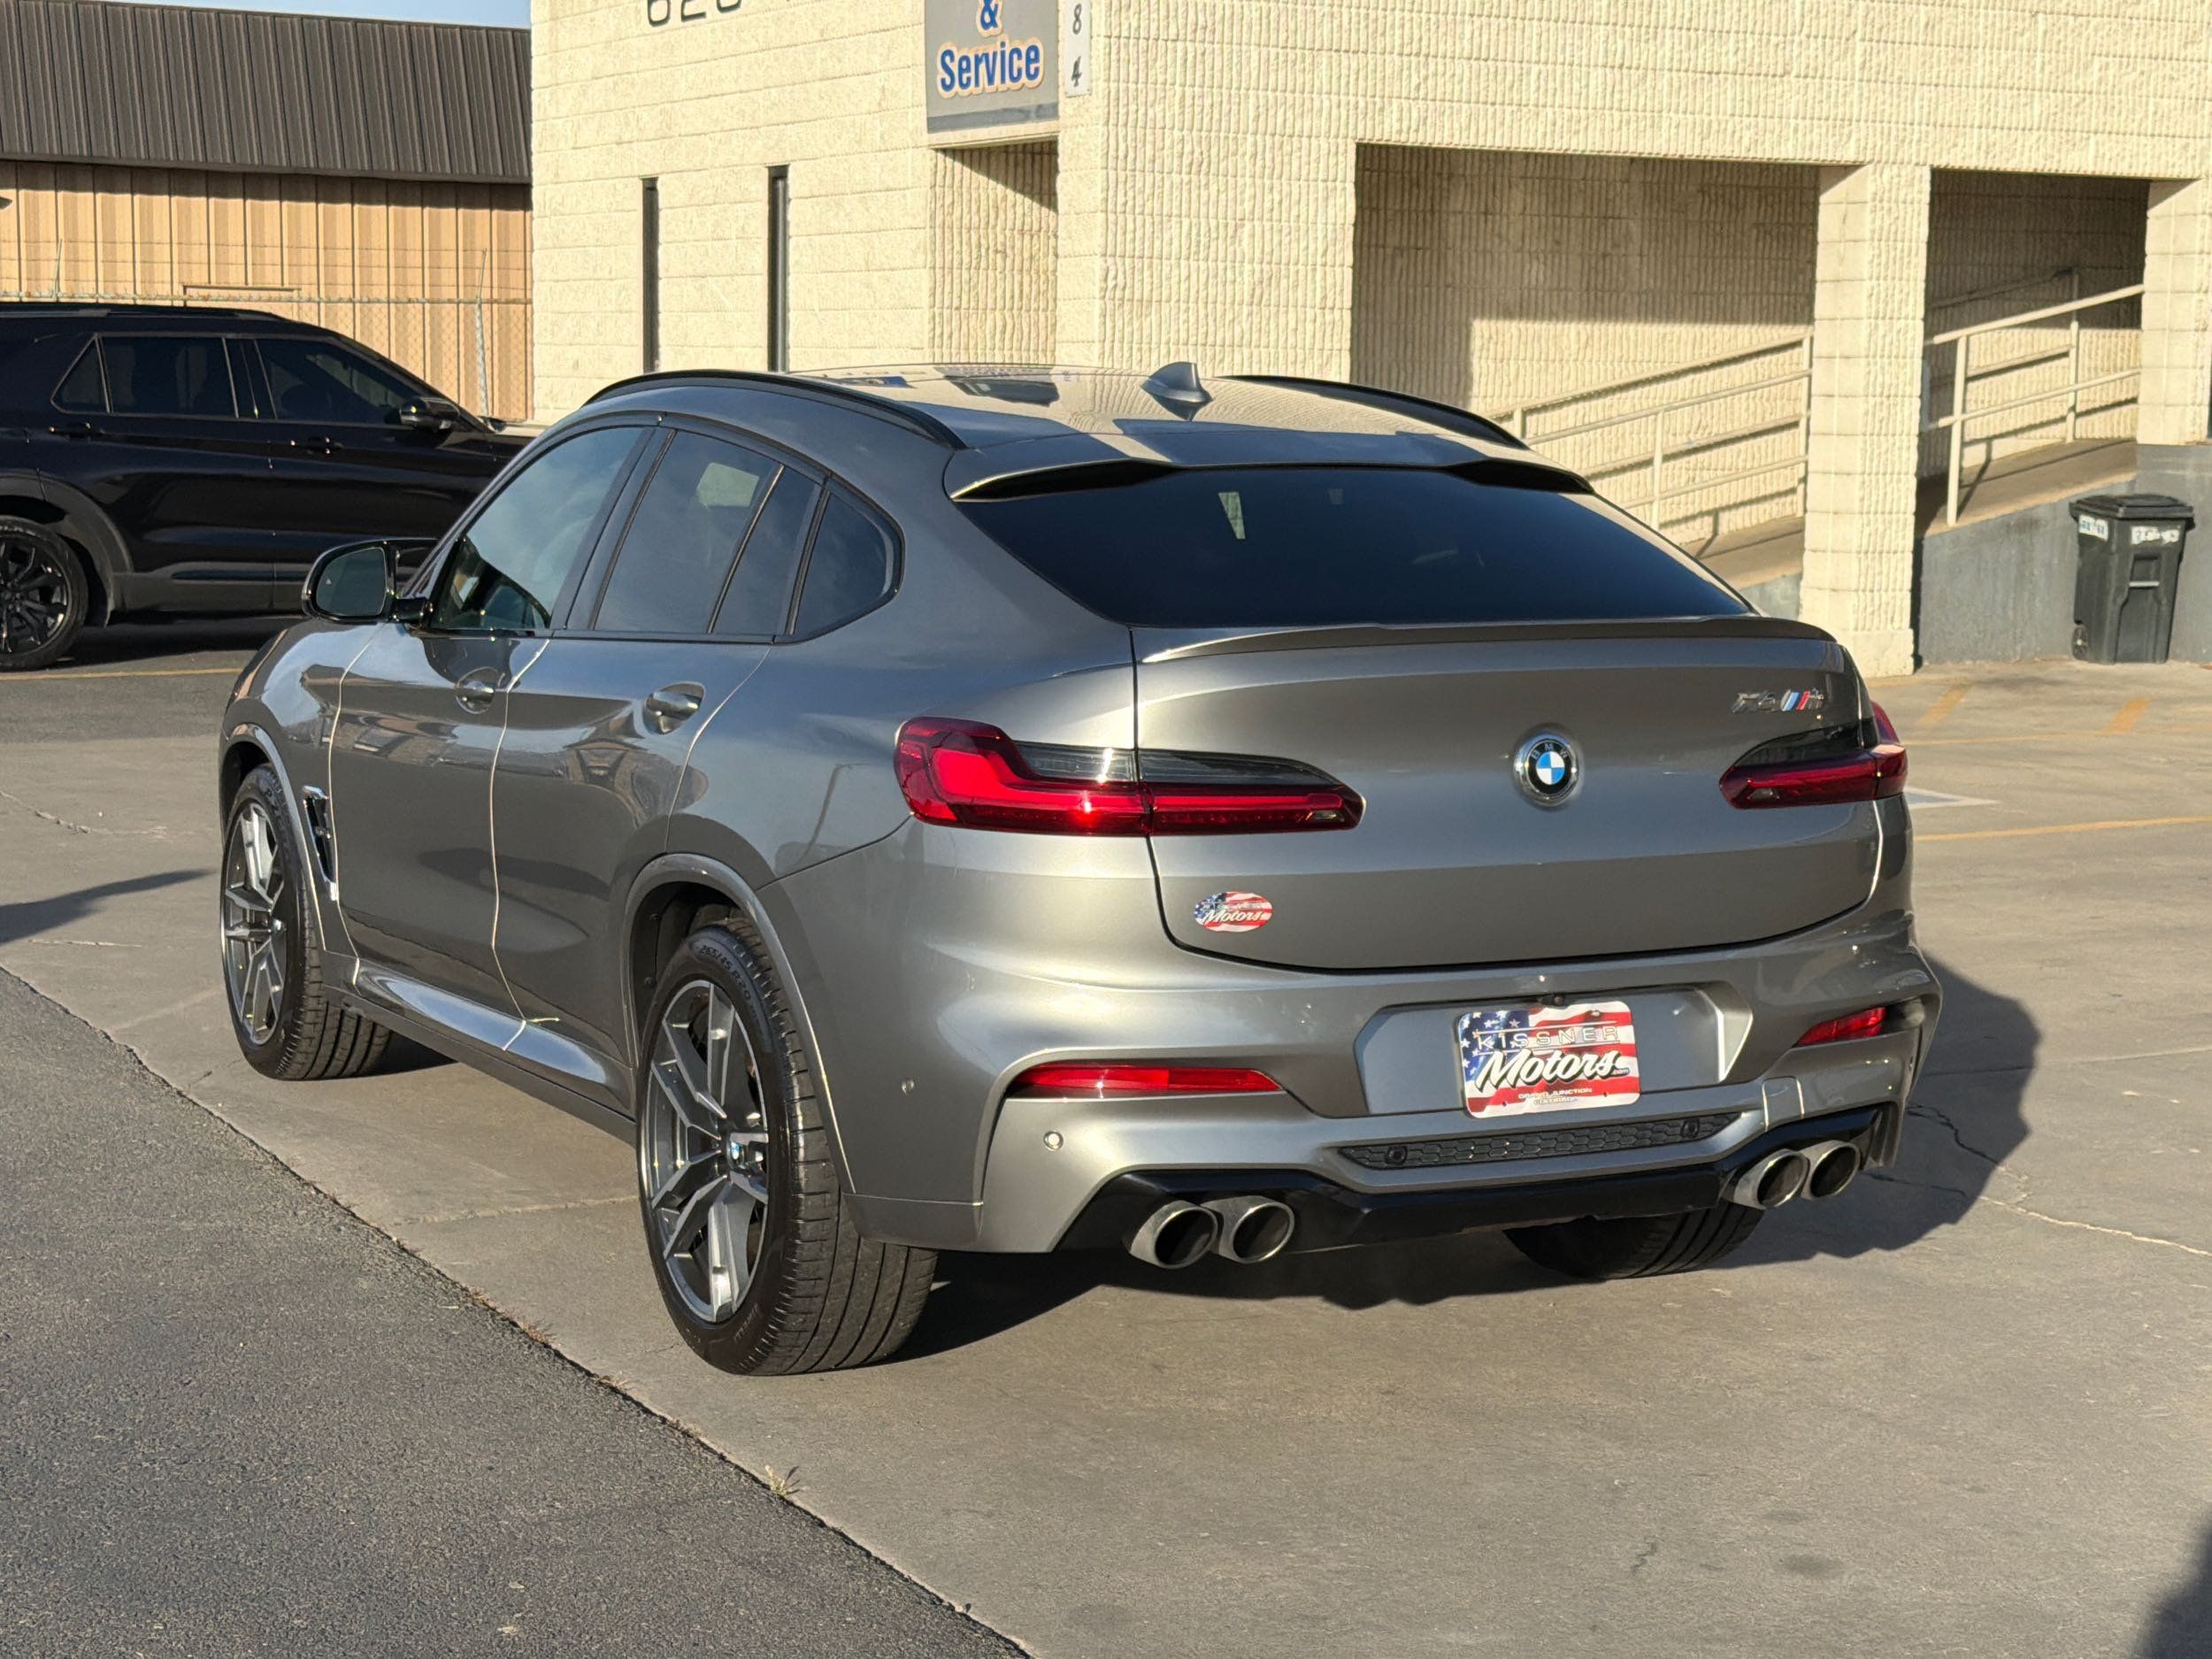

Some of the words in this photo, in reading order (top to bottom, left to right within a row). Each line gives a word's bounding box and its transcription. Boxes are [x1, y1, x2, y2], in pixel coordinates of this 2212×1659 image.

[941, 41, 1041, 92] Service
[1531, 742, 1568, 760] BMW
[1202, 909, 1263, 924] Motors
[1477, 1025, 1619, 1050] KISSNER
[1475, 1048, 1622, 1092] Motors
